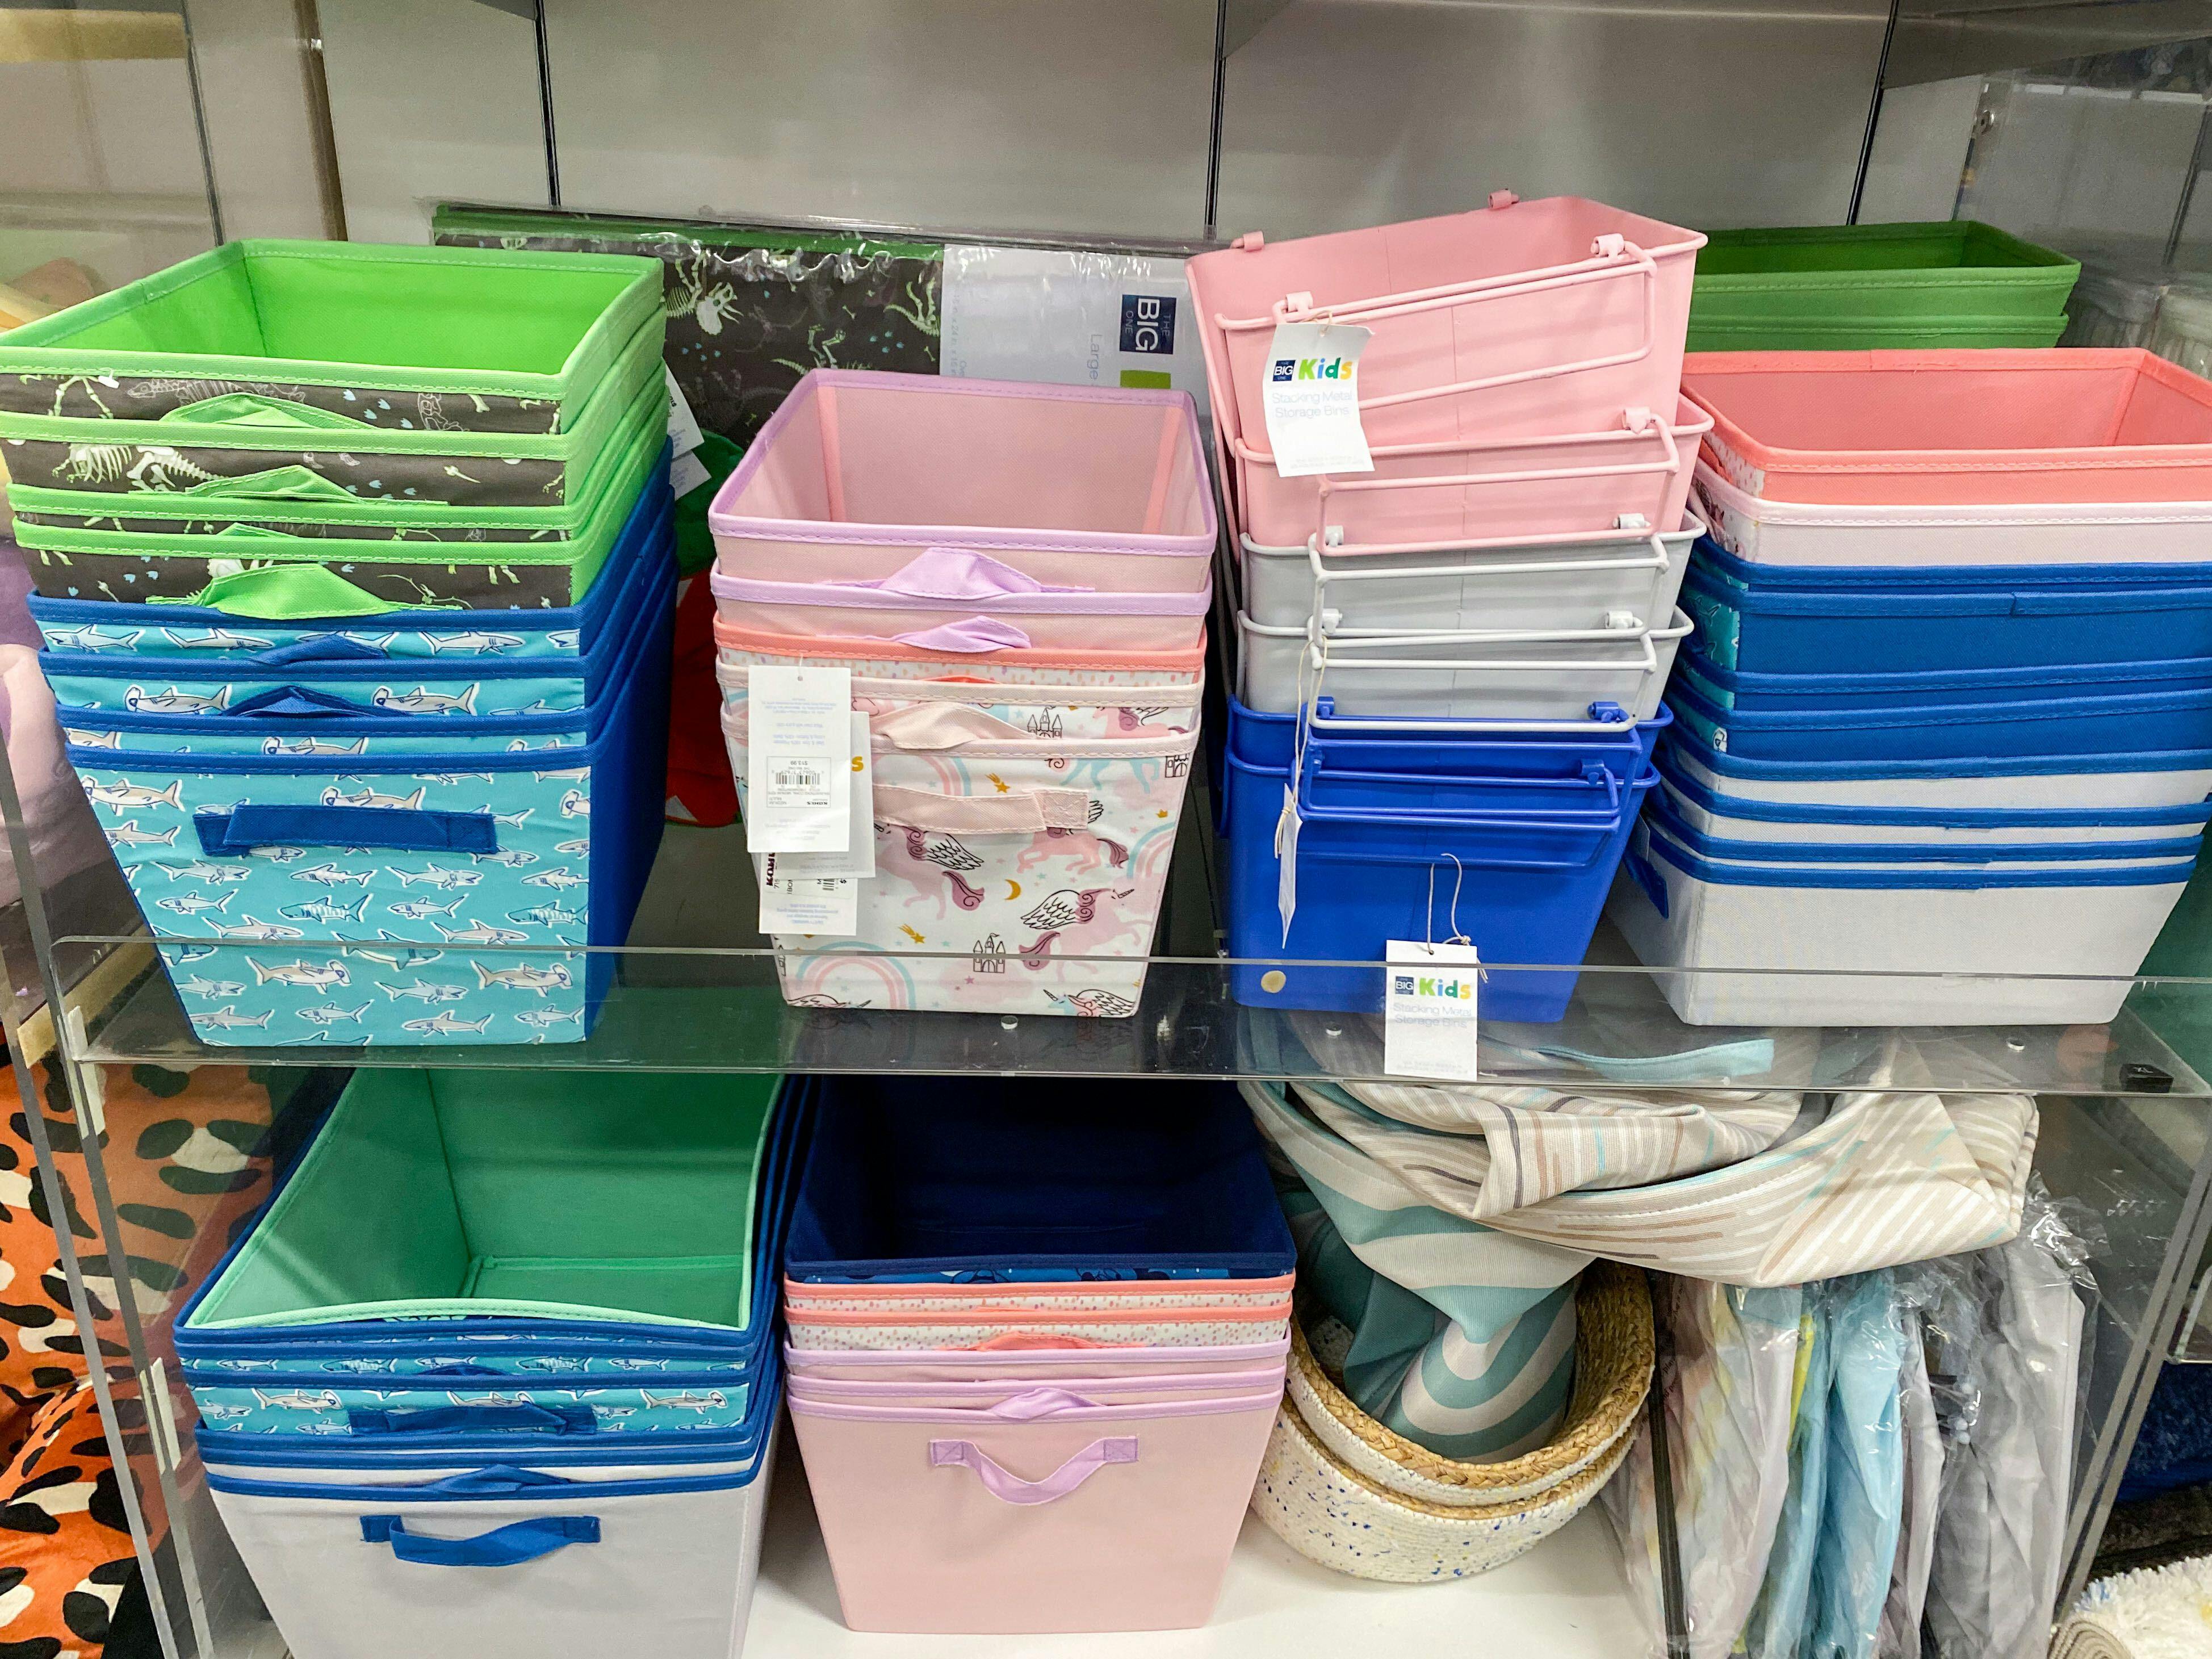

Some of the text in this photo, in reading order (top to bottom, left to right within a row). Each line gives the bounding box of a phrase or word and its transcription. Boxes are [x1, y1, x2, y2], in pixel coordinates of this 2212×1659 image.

[1124, 310, 1134, 337] ONE
[1136, 298, 1160, 351] BIG
[1162, 312, 1171, 337] THE
[1087, 334, 1103, 380] Large
[1273, 357, 1353, 380] BIG Kids
[1272, 390, 1353, 405] Stacking Metal
[1275, 405, 1350, 419] Storage Bins
[766, 852, 775, 886] KOHL
[1396, 977, 1472, 1000] BIG Kids
[1393, 1002, 1472, 1016] Stacking Metal
[1394, 1014, 1468, 1028] Storage Bins
